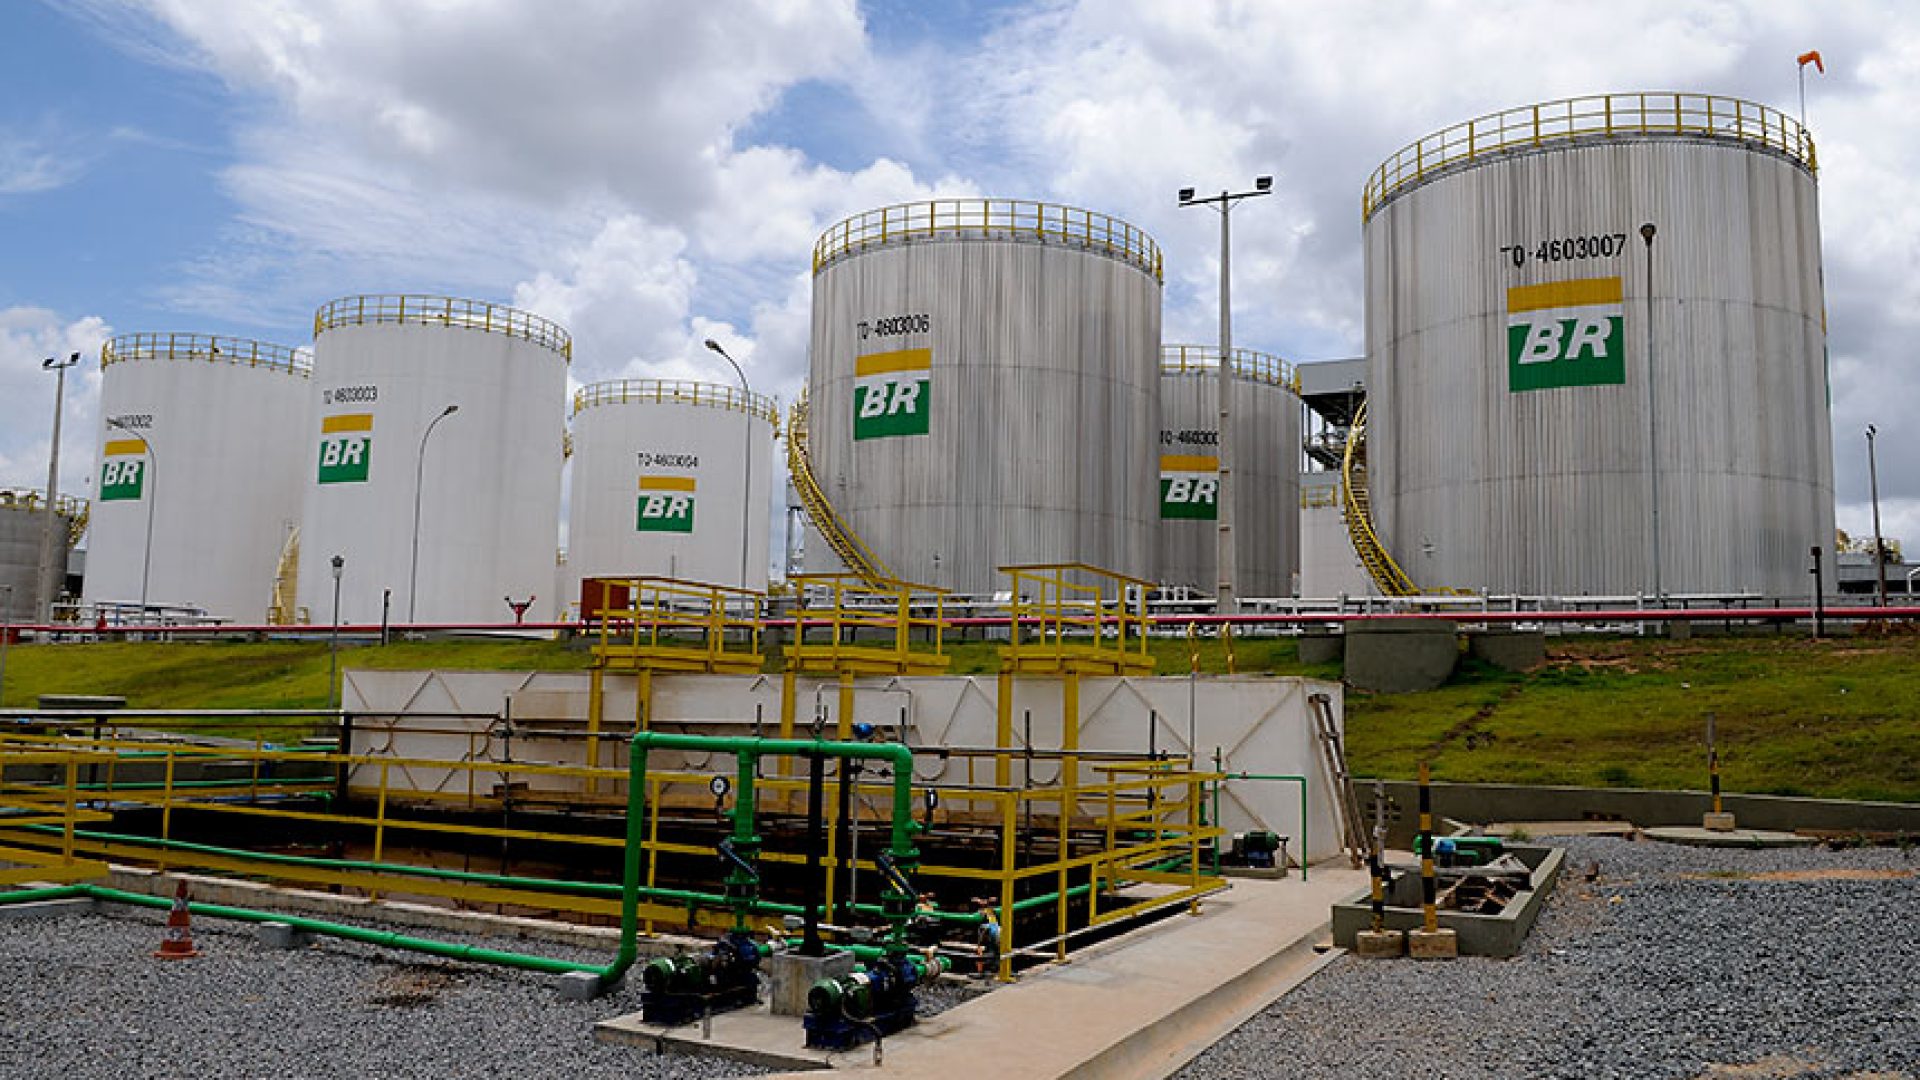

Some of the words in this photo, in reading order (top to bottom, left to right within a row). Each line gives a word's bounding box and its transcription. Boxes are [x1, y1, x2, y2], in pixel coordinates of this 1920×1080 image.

[1500, 234, 1626, 268] TQ-4603007
[1519, 317, 1612, 364] BR
[860, 379, 920, 418] BR
[322, 439, 365, 467] BR
[103, 461, 139, 486] BR
[1165, 477, 1217, 504] BR
[643, 495, 690, 519] BR
